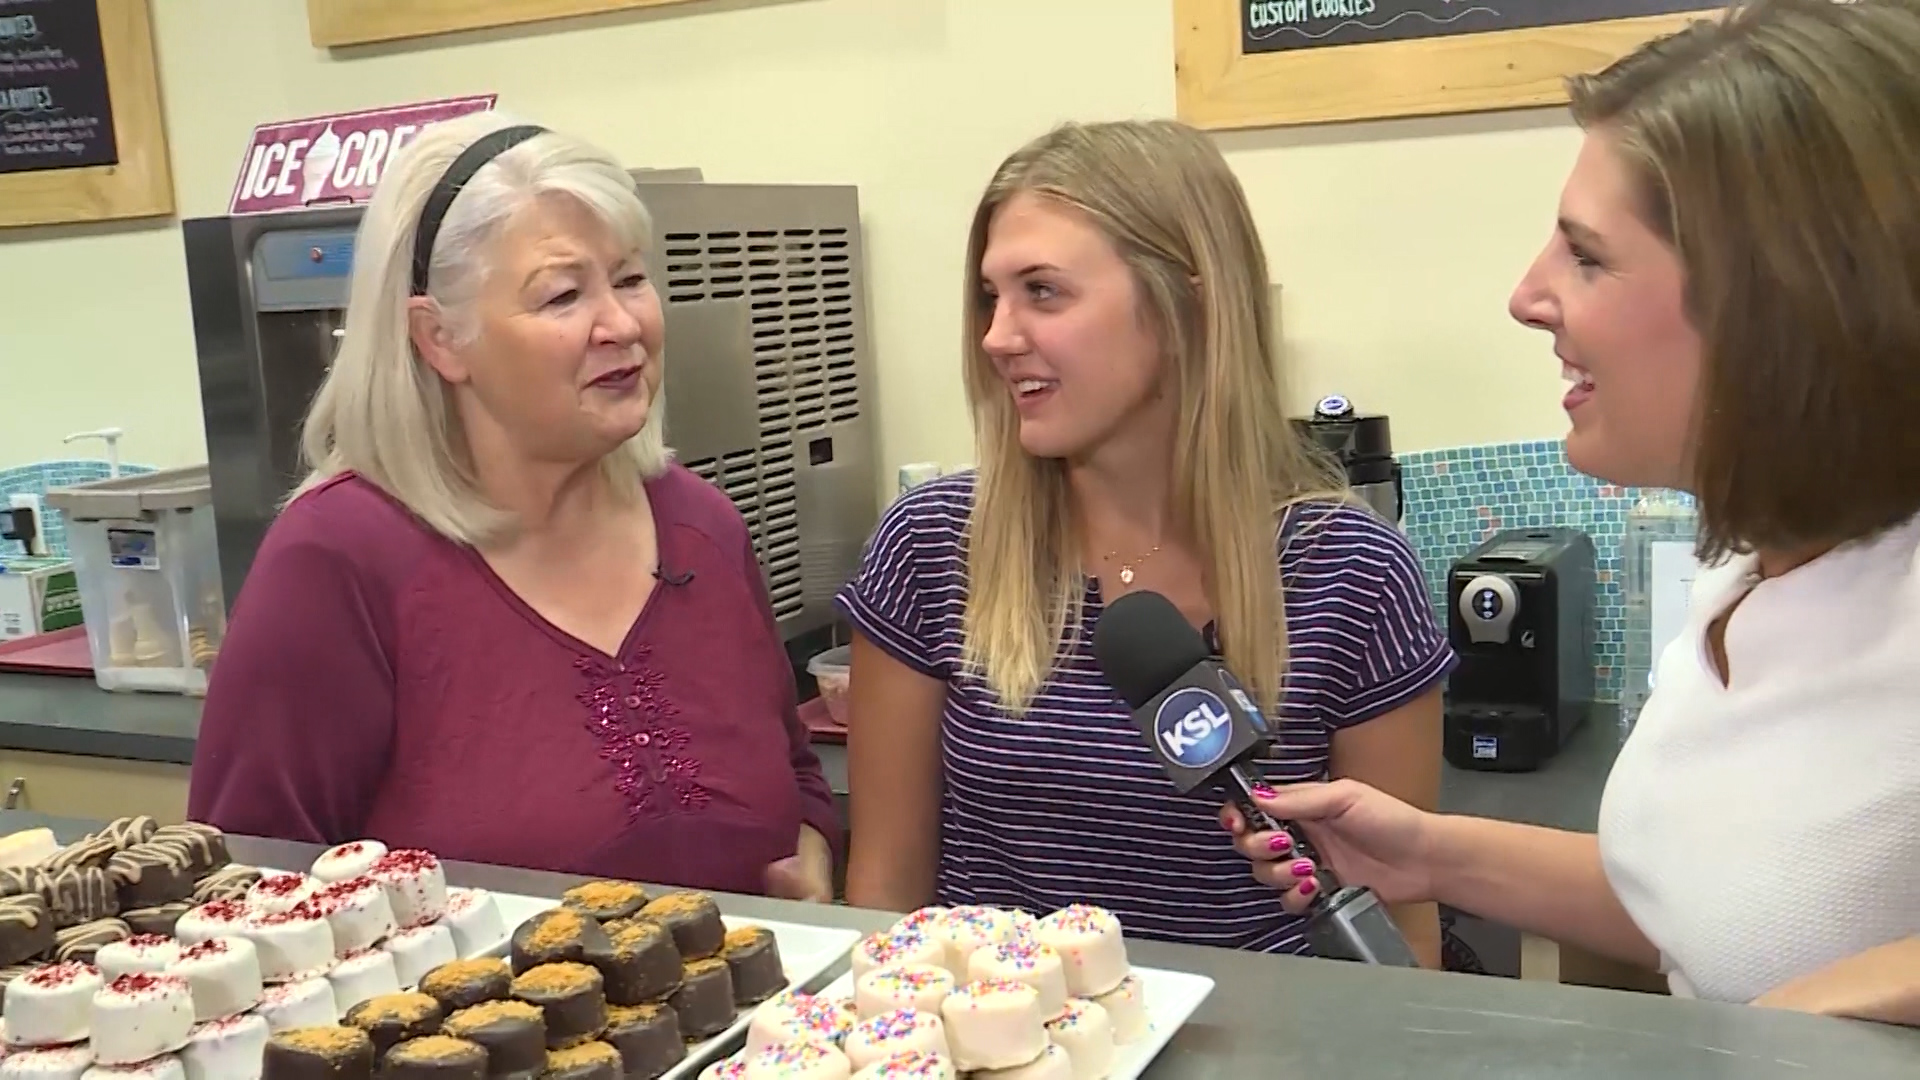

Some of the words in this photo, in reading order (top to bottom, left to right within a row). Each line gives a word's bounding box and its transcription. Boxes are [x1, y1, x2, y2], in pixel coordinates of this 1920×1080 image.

[1250, 0, 1308, 29] CUSTOM
[1312, 0, 1376, 18] COOKIES
[239, 138, 310, 201] ICE
[1161, 702, 1230, 758] KSL
